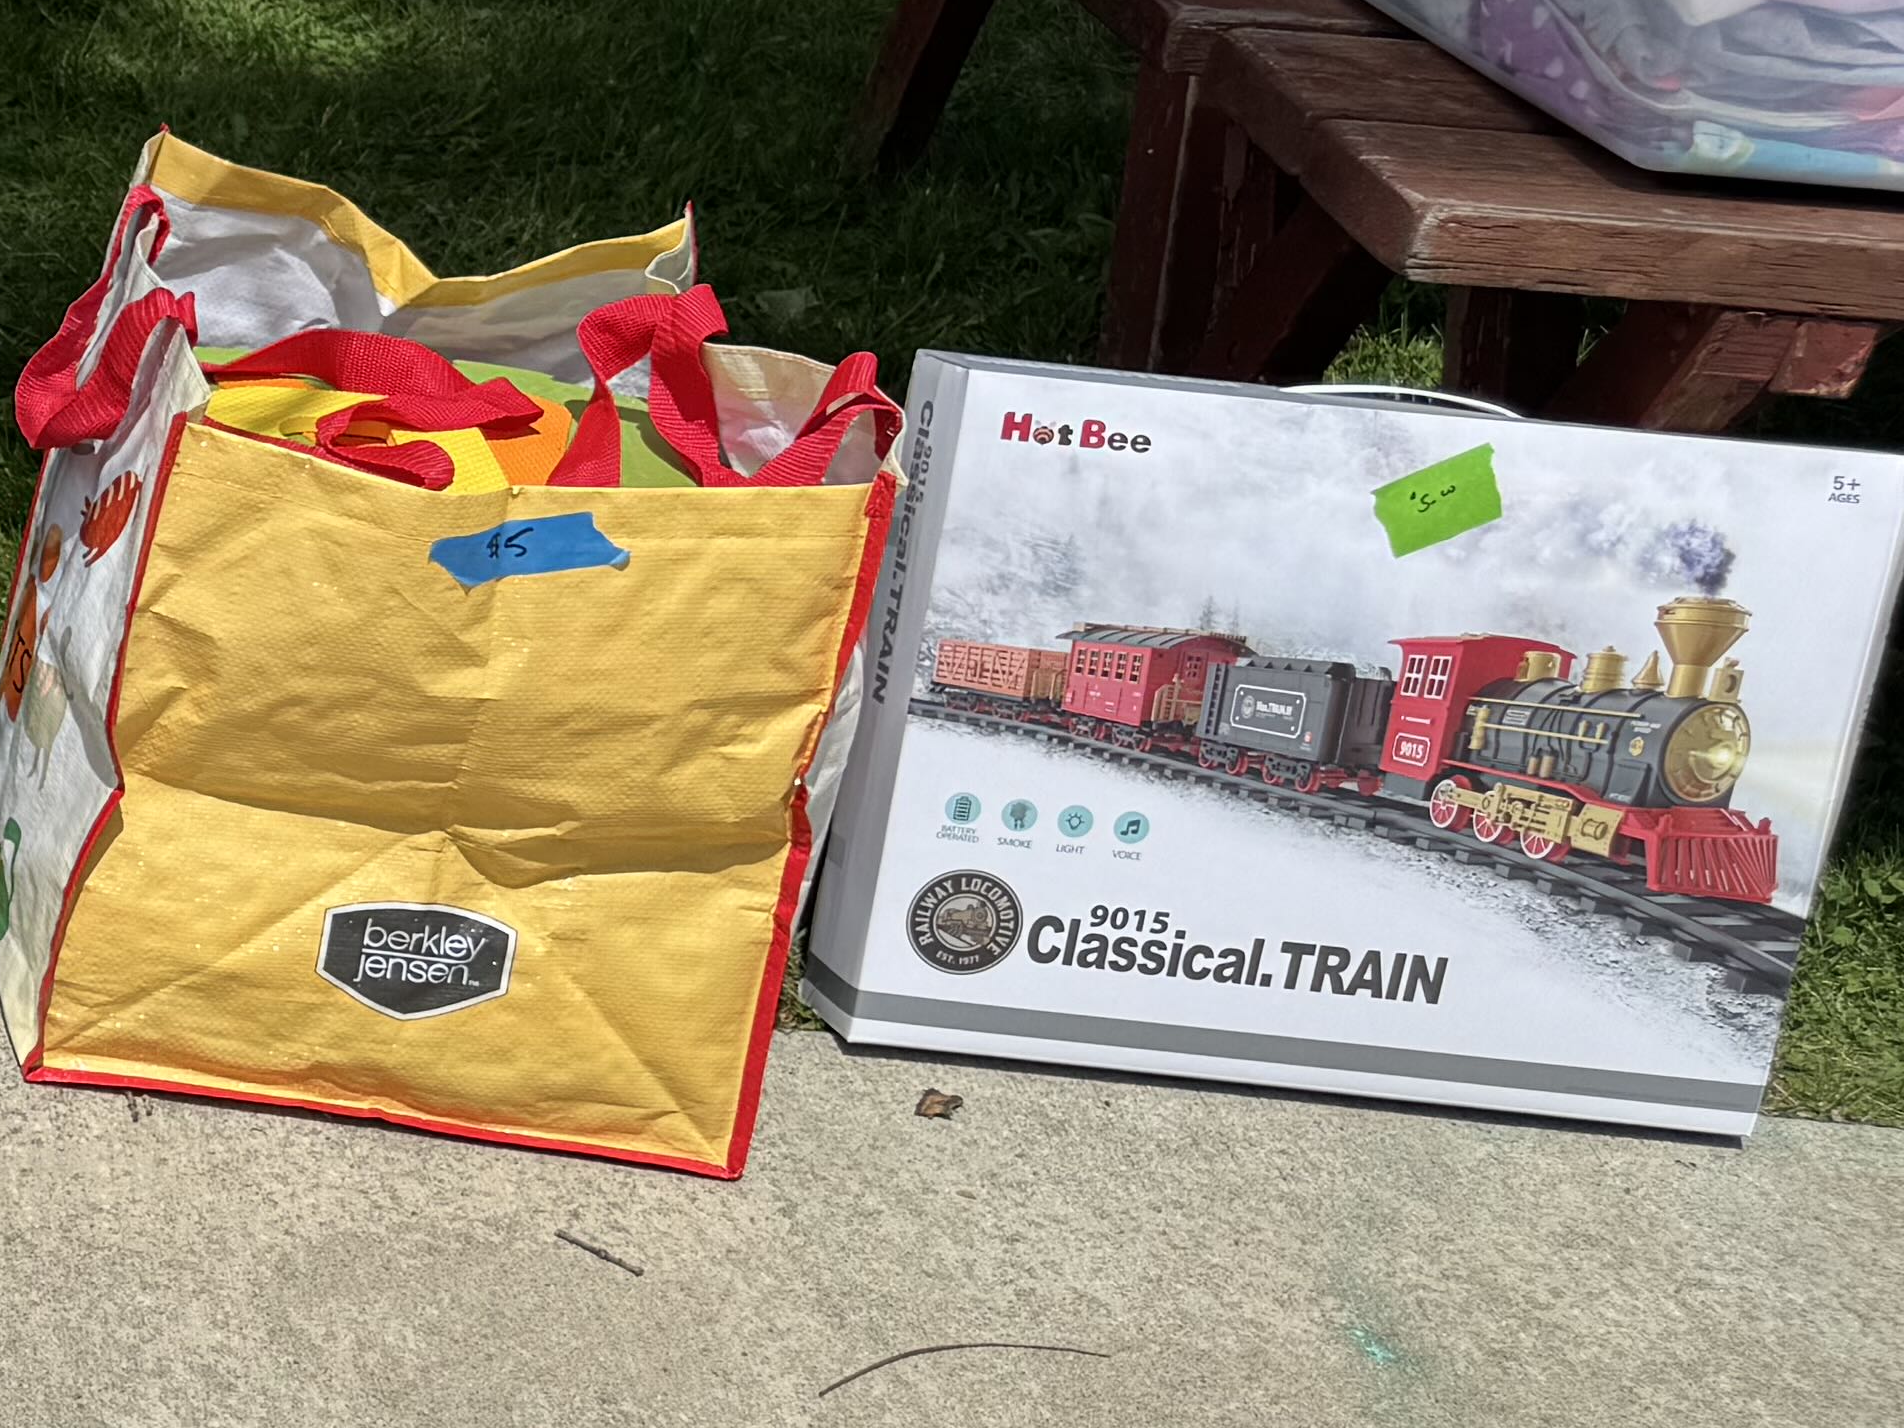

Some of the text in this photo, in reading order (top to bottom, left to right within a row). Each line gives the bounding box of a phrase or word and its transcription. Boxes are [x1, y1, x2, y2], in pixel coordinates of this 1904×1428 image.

[1079, 419, 1152, 453] Bee
[1833, 475, 1861, 491] 5+
[1828, 492, 1861, 504] AGES
[1399, 741, 1424, 759] 9015
[997, 837, 1032, 849] SMOKE
[1055, 844, 1085, 855] LIGHT
[1112, 850, 1142, 861] VOICE
[915, 877, 1016, 956] RAILWAY LOCOMOTIVE
[1090, 904, 1170, 933] 9015
[362, 918, 486, 963] berkley
[353, 954, 469, 986] jensen
